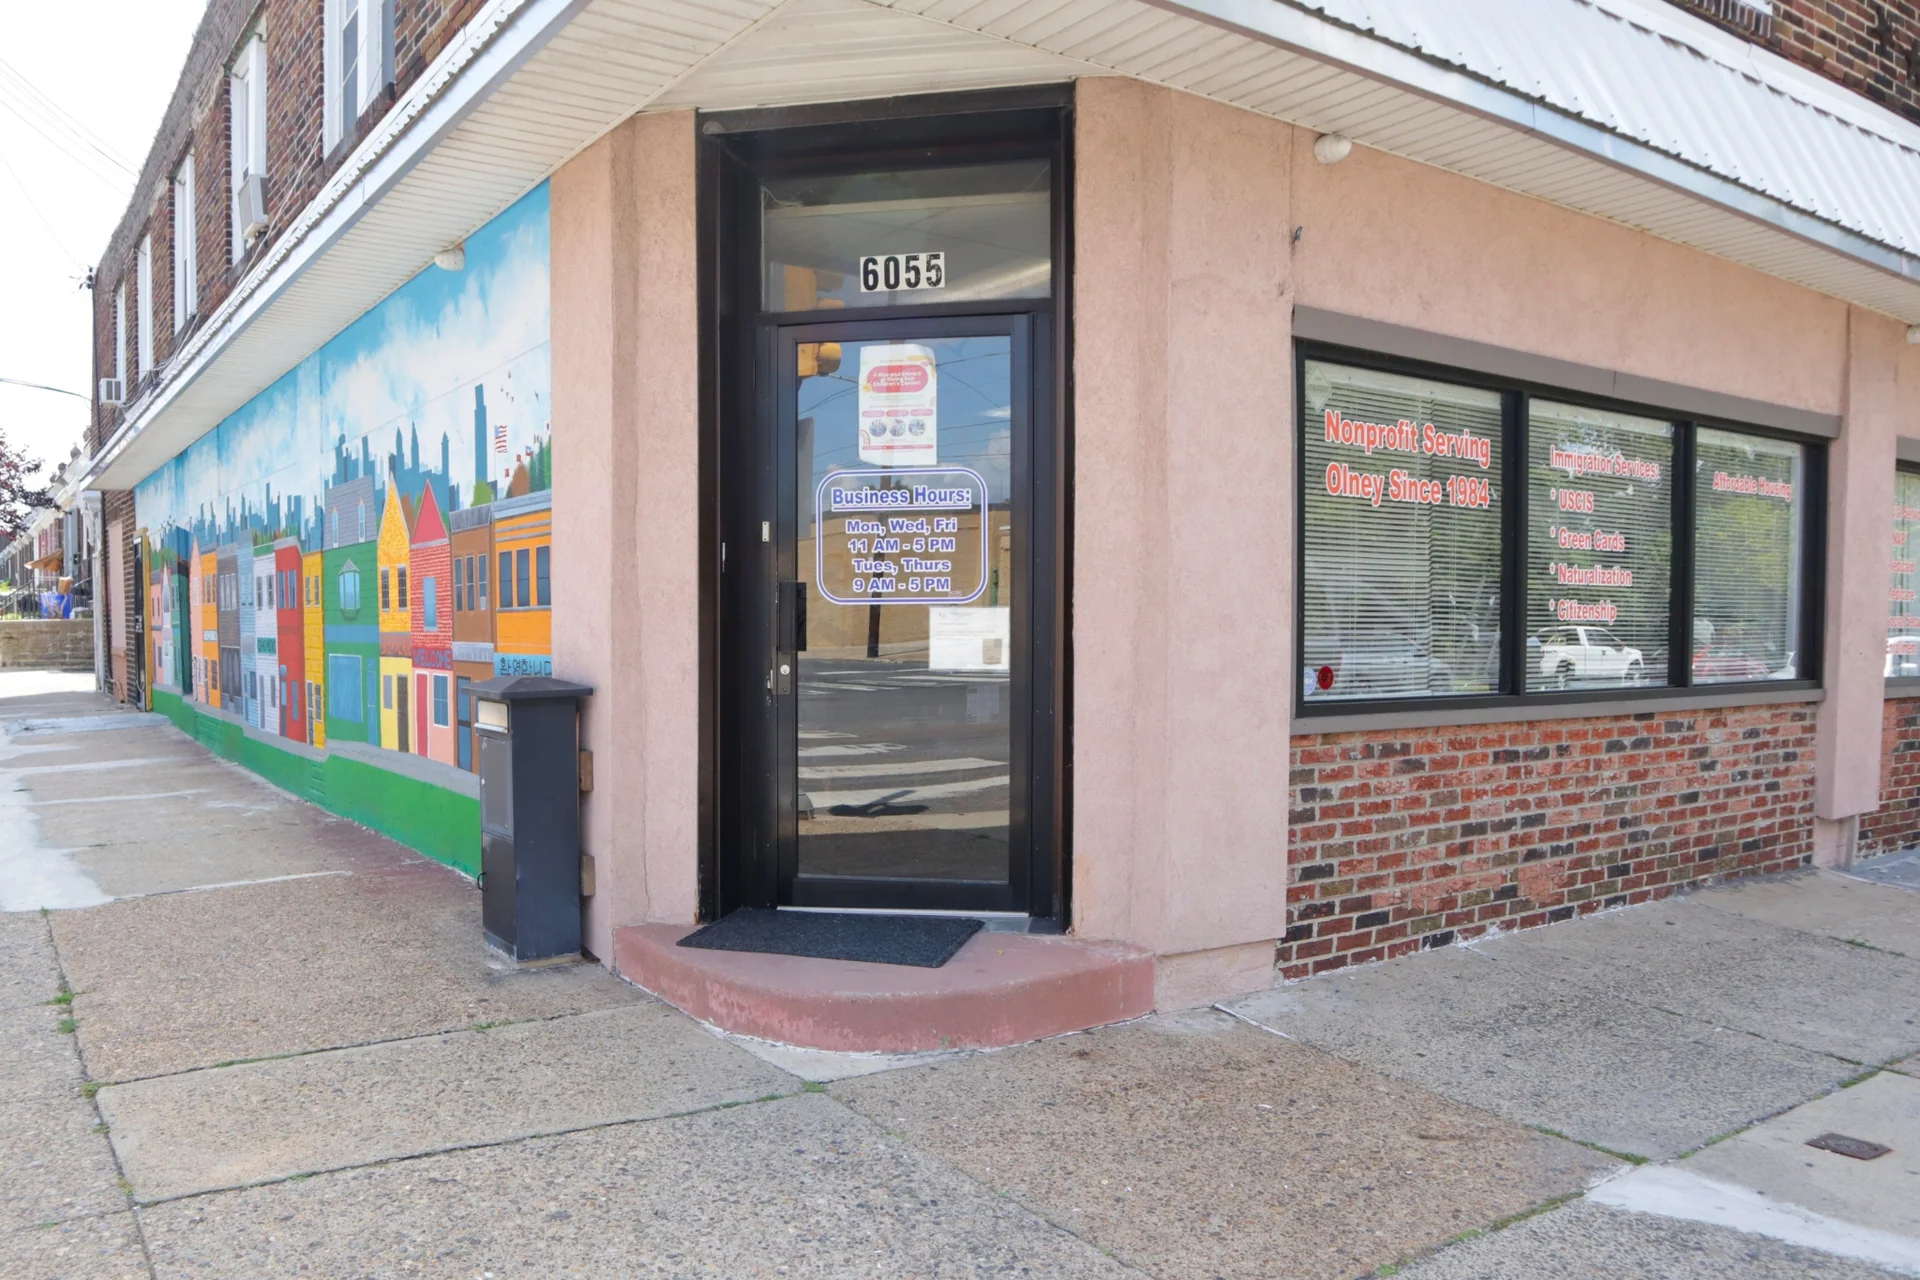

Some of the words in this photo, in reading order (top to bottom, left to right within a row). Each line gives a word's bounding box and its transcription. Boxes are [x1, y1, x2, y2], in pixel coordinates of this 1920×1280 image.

[862, 253, 942, 291] 6055
[1324, 409, 1418, 454] Nonprofit
[1423, 423, 1491, 468] Serving
[1550, 445, 1612, 475] Immigration
[832, 486, 909, 505] Business
[914, 485, 971, 504] Hours:
[1326, 462, 1385, 507] Olney
[1389, 468, 1442, 504] Since
[1447, 475, 1490, 508] 1984
[1712, 471, 1757, 494] Affordable
[1758, 477, 1792, 502] Housing
[1559, 489, 1594, 513] USCIS
[846, 519, 886, 534] Mon,
[889, 518, 930, 533] Wed,
[934, 518, 957, 532] Fri
[848, 539, 868, 552] 11
[873, 539, 899, 552] AM
[913, 539, 924, 552] 5
[929, 538, 955, 552] PM
[1558, 527, 1592, 549] Green
[1594, 529, 1624, 552] Cards
[853, 559, 898, 574] Tues,
[902, 558, 951, 572] Thurs
[1558, 563, 1633, 587] Naturalization
[853, 579, 864, 592] 9
[869, 578, 895, 592] AM
[909, 578, 920, 591] 5
[925, 578, 951, 592] PM
[1557, 599, 1617, 626] Citizenship
[414, 648, 452, 670] WELCOME
